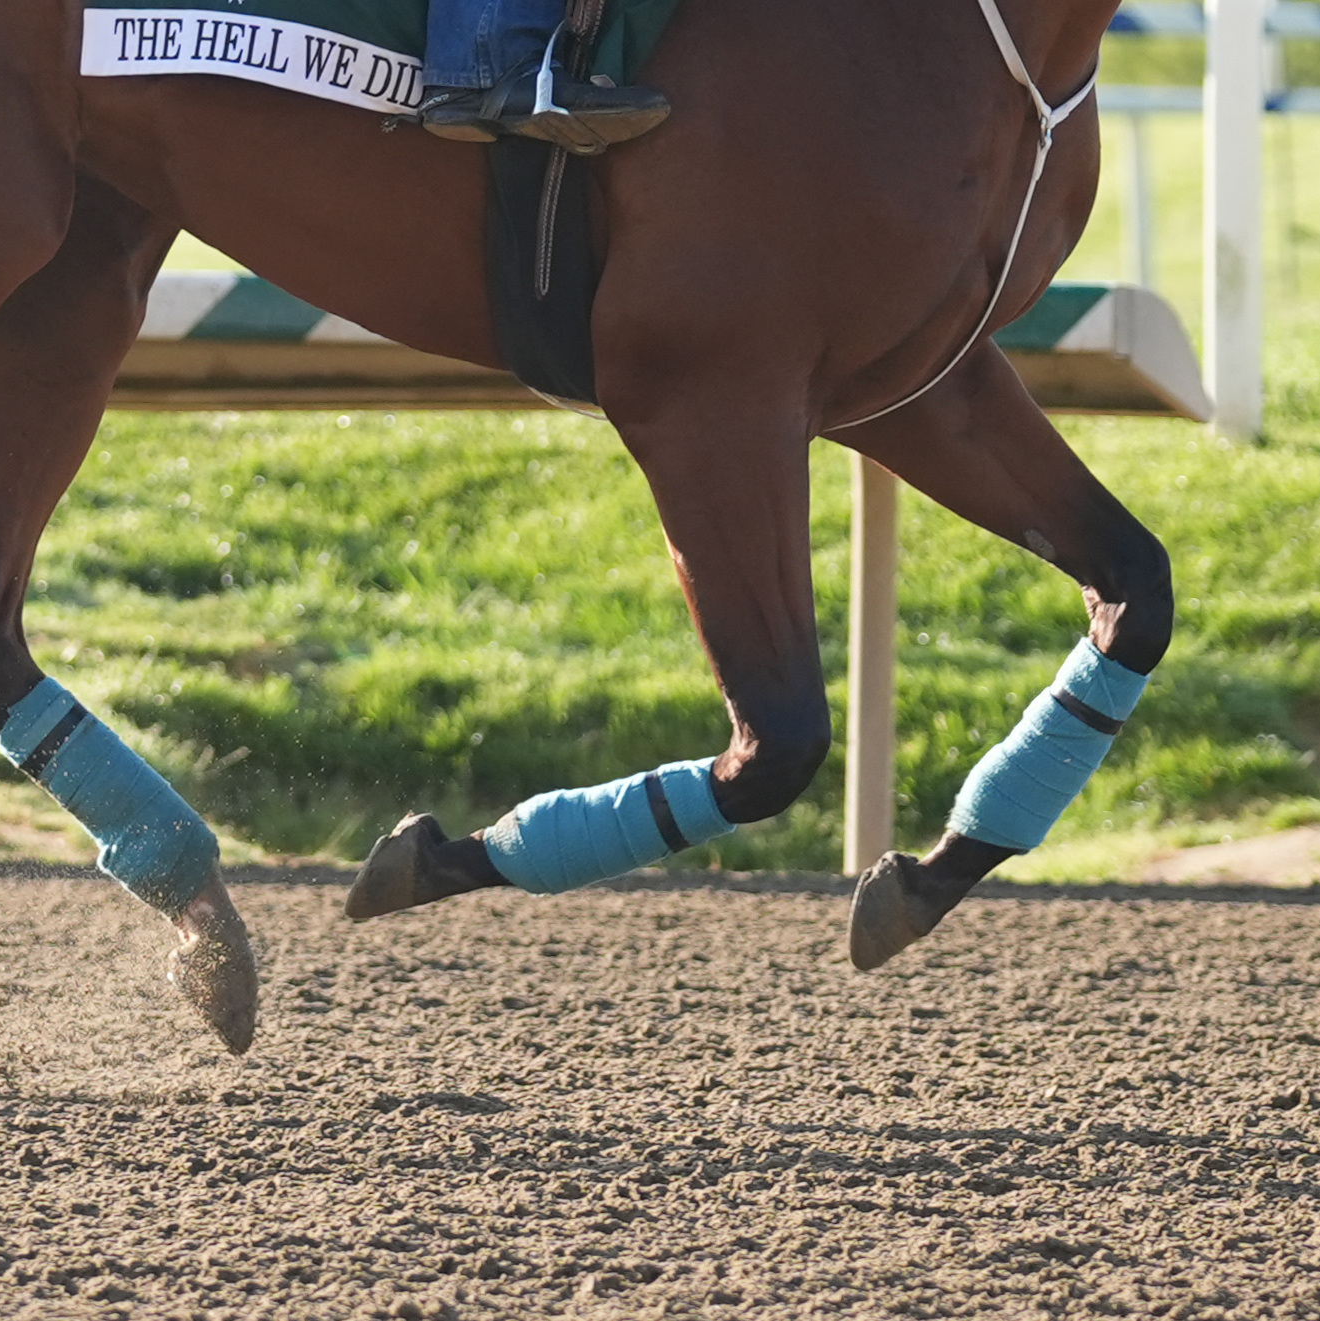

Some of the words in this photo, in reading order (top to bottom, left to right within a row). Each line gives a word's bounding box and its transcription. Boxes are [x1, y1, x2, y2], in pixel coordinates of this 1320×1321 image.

[115, 18, 183, 62] THE
[191, 18, 290, 74] HELL
[304, 34, 359, 90] WE
